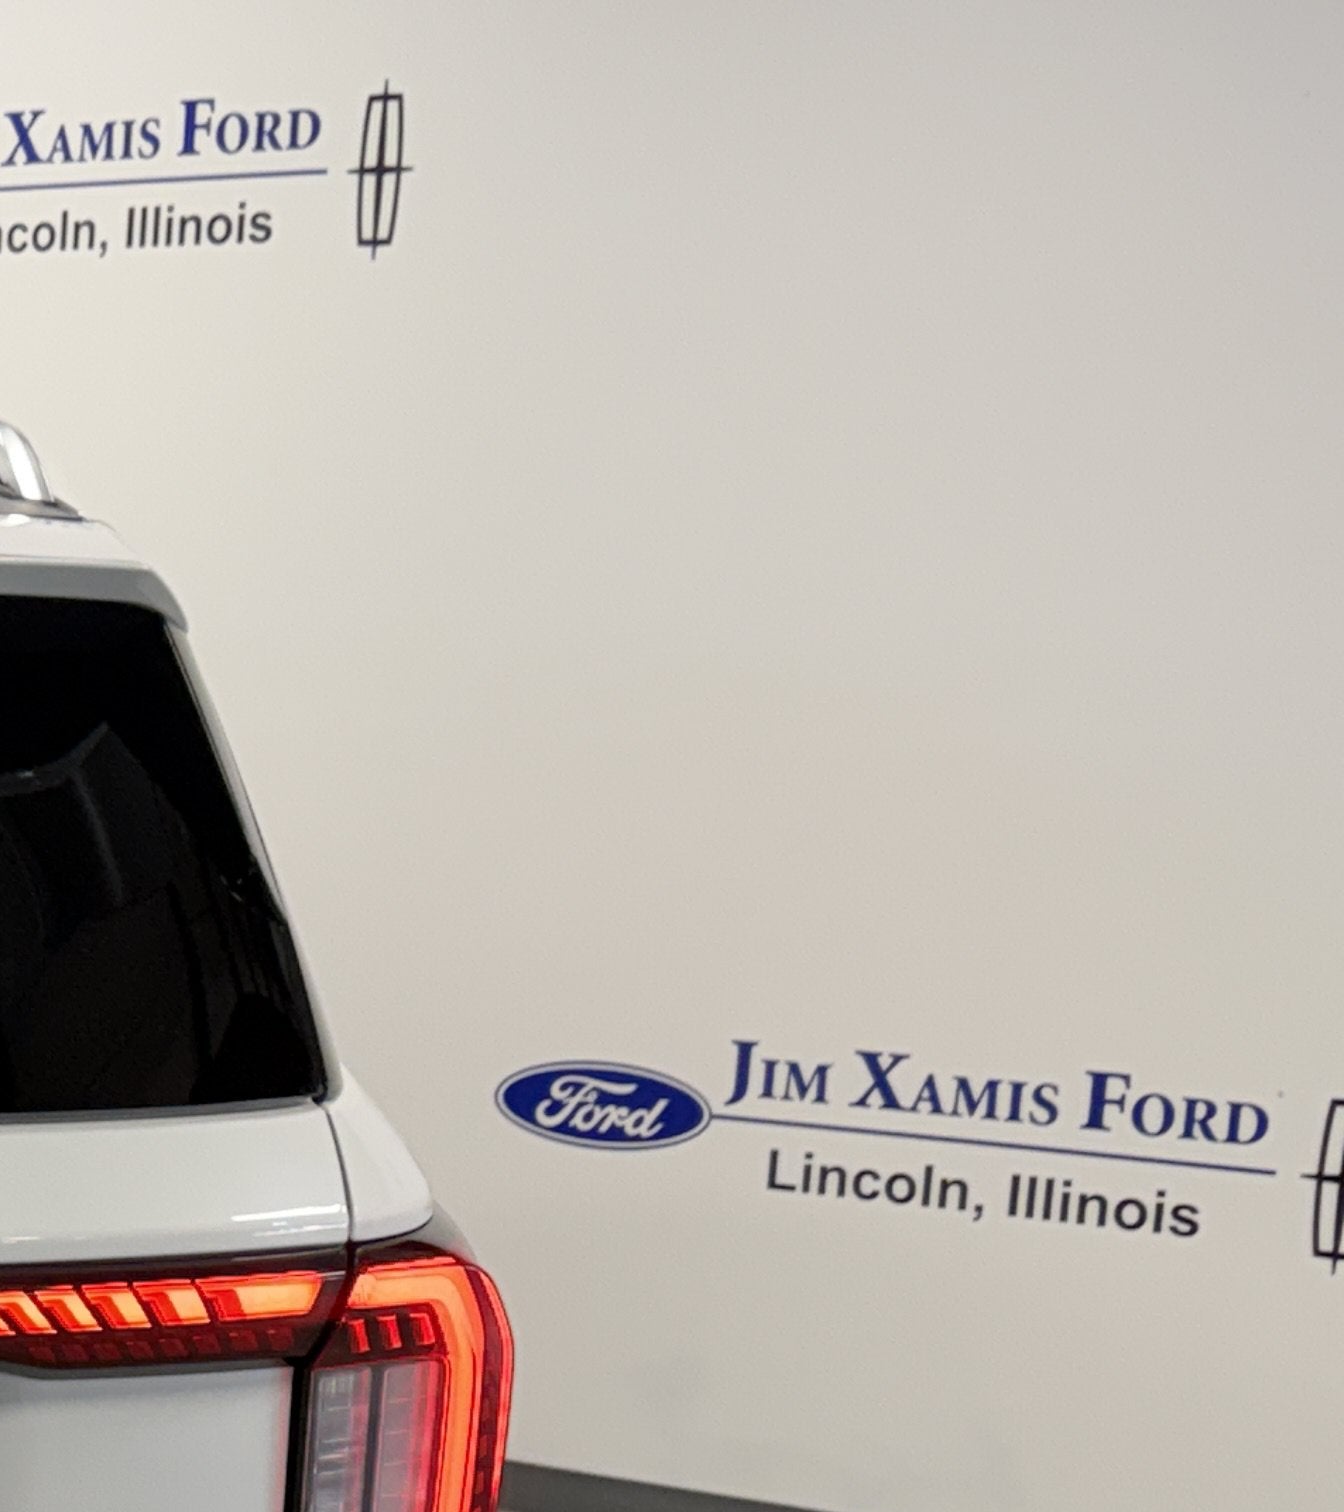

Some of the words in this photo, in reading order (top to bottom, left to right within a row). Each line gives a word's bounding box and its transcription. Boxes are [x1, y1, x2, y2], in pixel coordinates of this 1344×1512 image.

[1, 110, 161, 168] XAMIS
[177, 97, 322, 157] FORD
[126, 202, 273, 249] Illinois
[535, 1075, 671, 1139] Ford
[725, 1040, 831, 1106] JIM
[849, 1050, 1059, 1126] XAMIS
[1080, 1070, 1270, 1147] FORD
[766, 1150, 984, 1221] Lincoln,
[1007, 1173, 1201, 1237] Illinois
